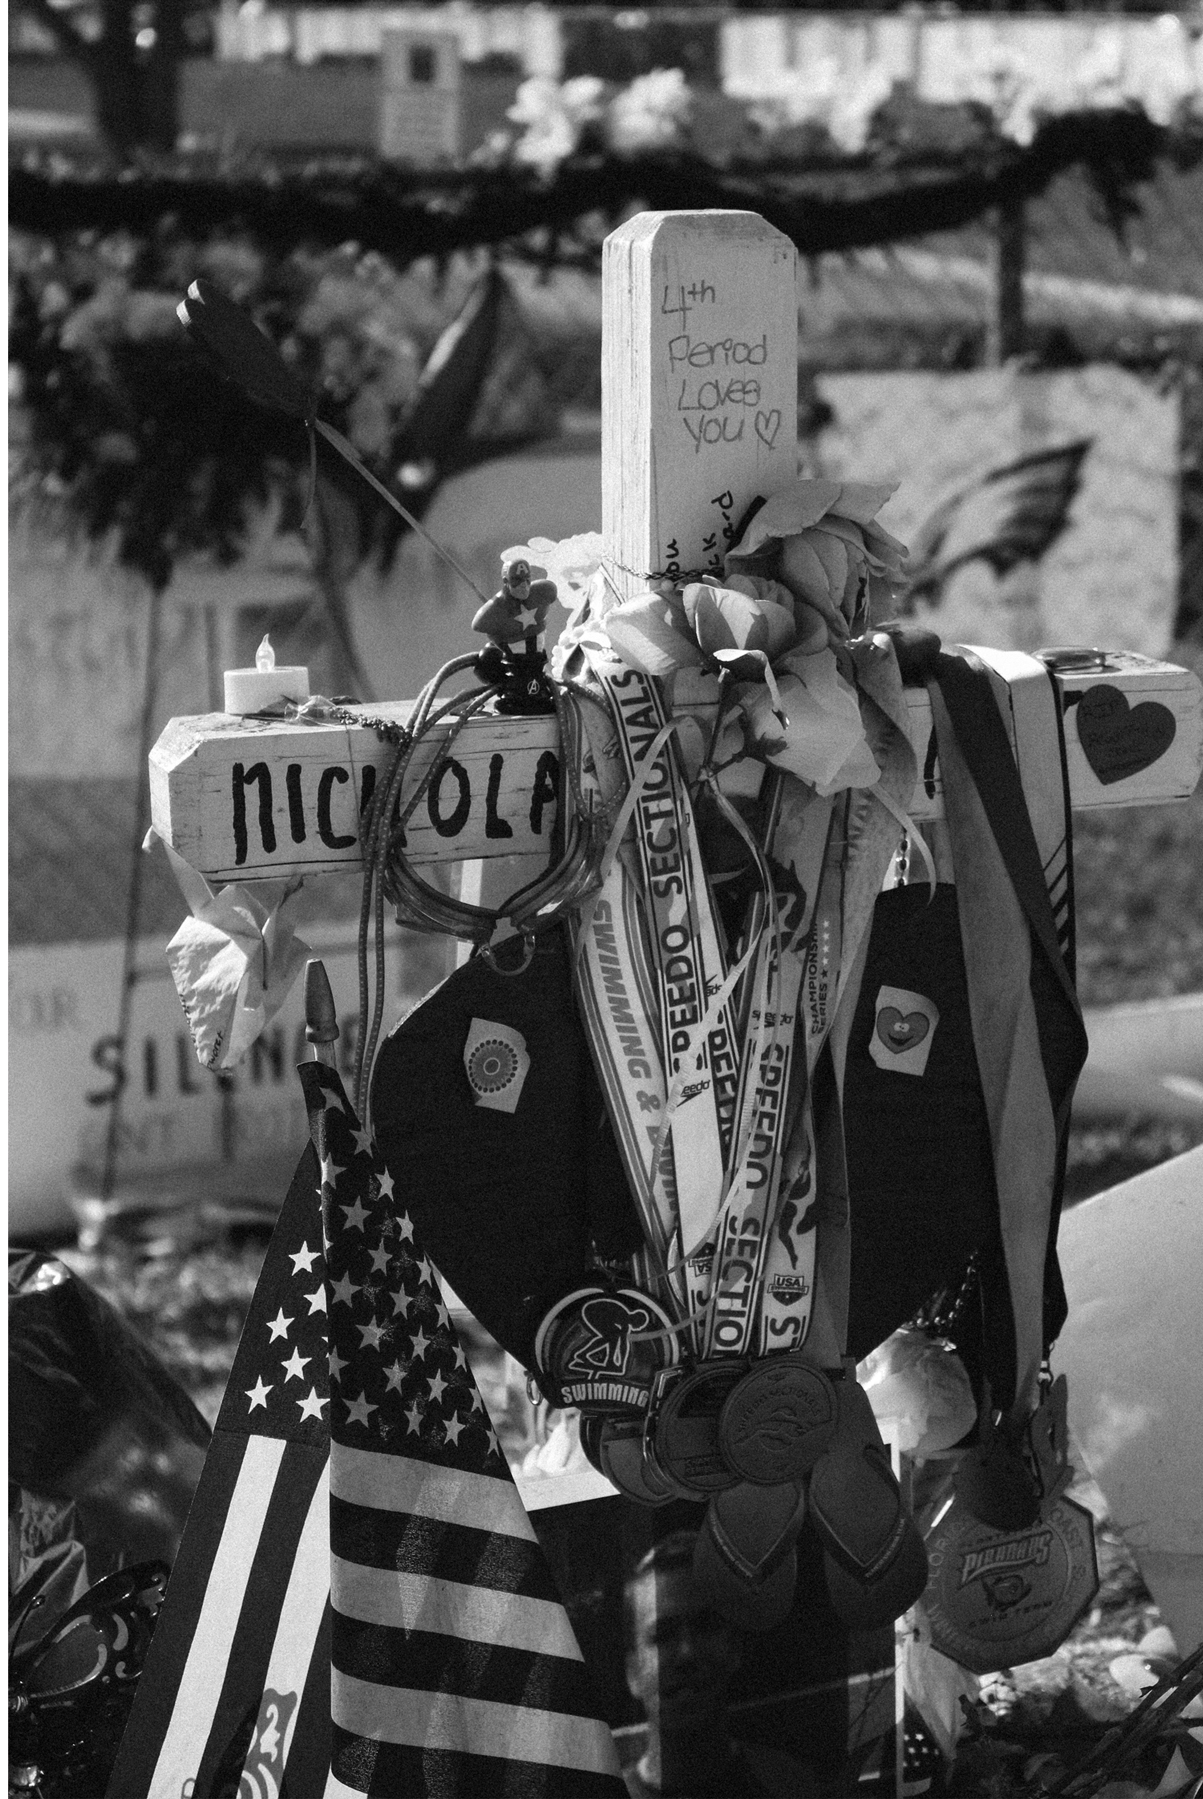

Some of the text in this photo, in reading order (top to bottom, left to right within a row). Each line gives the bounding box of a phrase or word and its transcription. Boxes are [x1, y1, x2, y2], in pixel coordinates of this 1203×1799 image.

[661, 279, 716, 331] 4th
[668, 334, 768, 373] Period
[711, 490, 735, 541] ard
[233, 751, 560, 866] NICOLA
[592, 900, 651, 1080] SWIMMING
[636, 1089, 662, 1114] &
[681, 1078, 712, 1096] eedo
[713, 1215, 761, 1354] SECTIO
[776, 1276, 801, 1288] USA
[560, 1382, 649, 1408] SWIMMING
